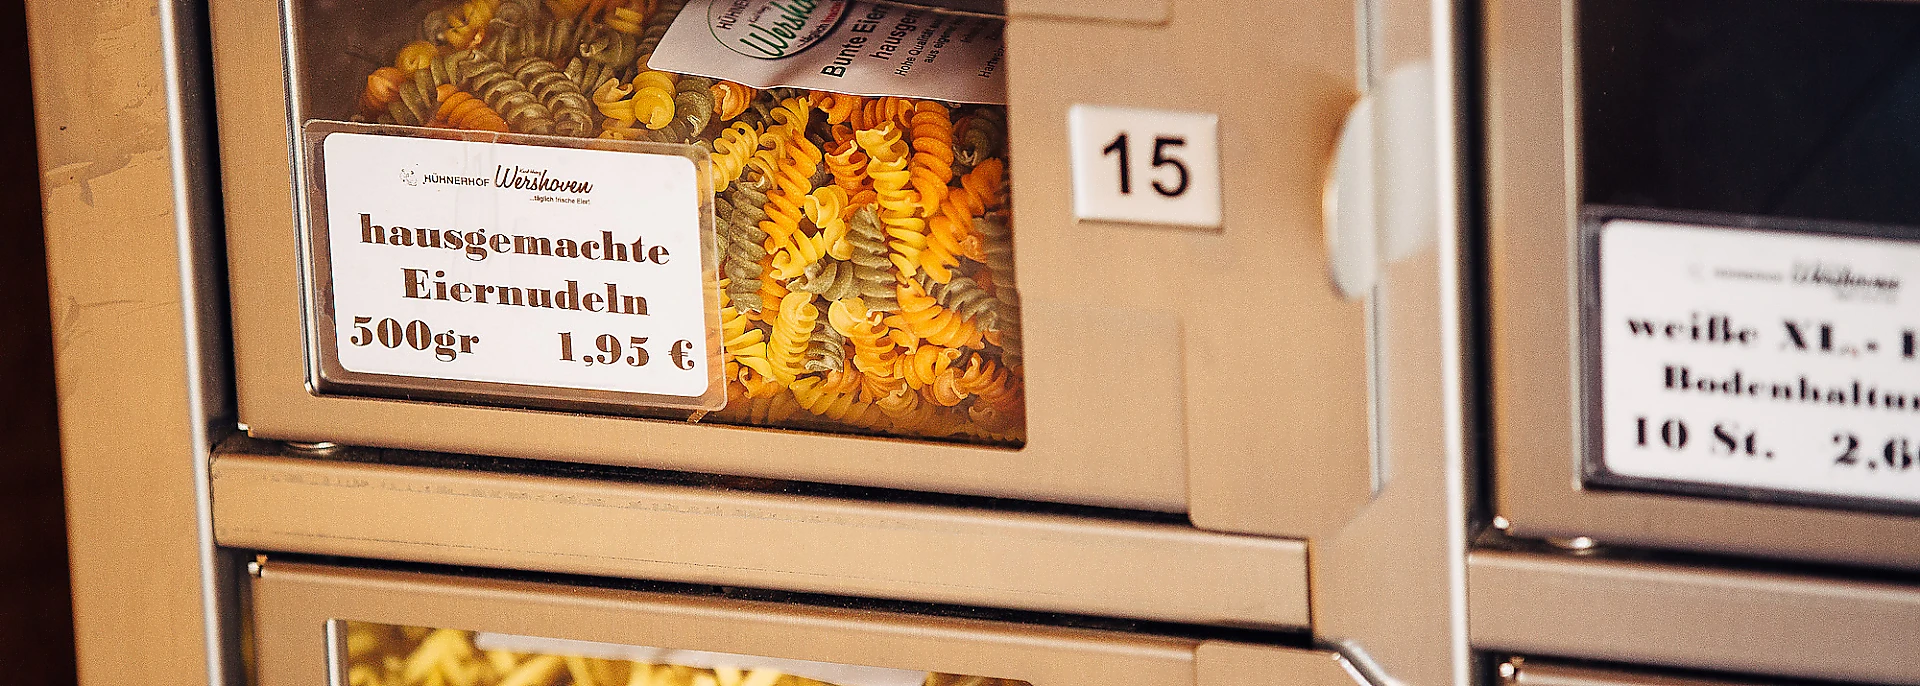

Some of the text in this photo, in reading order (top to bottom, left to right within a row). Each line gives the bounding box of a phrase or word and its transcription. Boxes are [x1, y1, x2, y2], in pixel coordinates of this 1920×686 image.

[820, 36, 868, 78] Bunte
[895, 55, 917, 77] Hohe
[424, 172, 490, 187] HÜHNERHOF
[494, 165, 593, 194] Wershoven
[1102, 131, 1192, 199] 15
[358, 213, 670, 265] hausgemachte
[401, 268, 651, 317] Eiernudeln
[350, 316, 695, 371] 500gr 1,95 €
[1636, 416, 1689, 450] 10
[1711, 423, 1774, 460] St.
